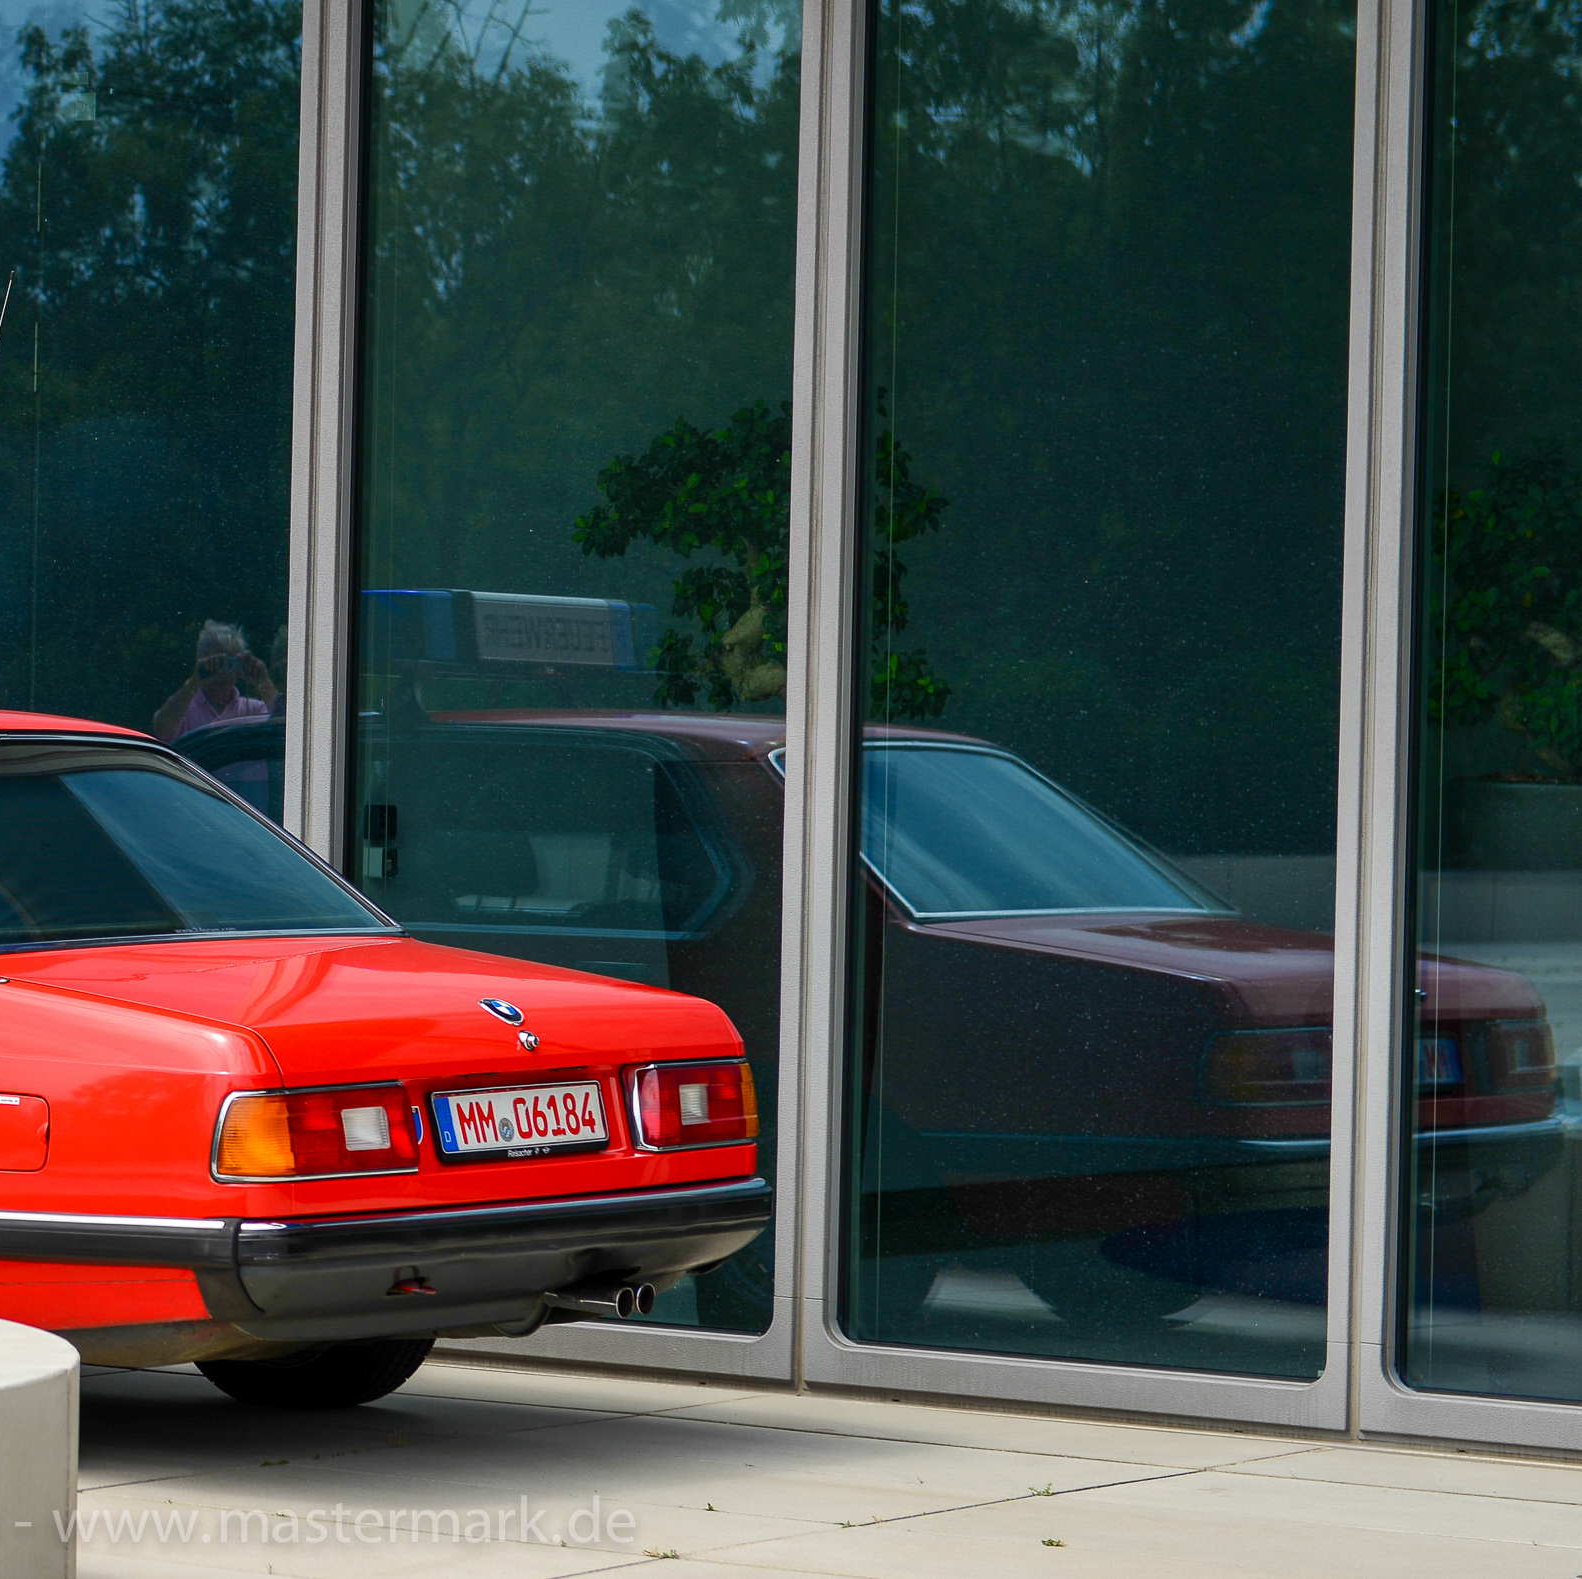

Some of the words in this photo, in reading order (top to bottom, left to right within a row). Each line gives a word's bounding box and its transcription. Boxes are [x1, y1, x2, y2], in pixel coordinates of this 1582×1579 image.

[456, 1100, 498, 1144] MM
[513, 1092, 596, 1139] 06184
[444, 1131, 452, 1143] D
